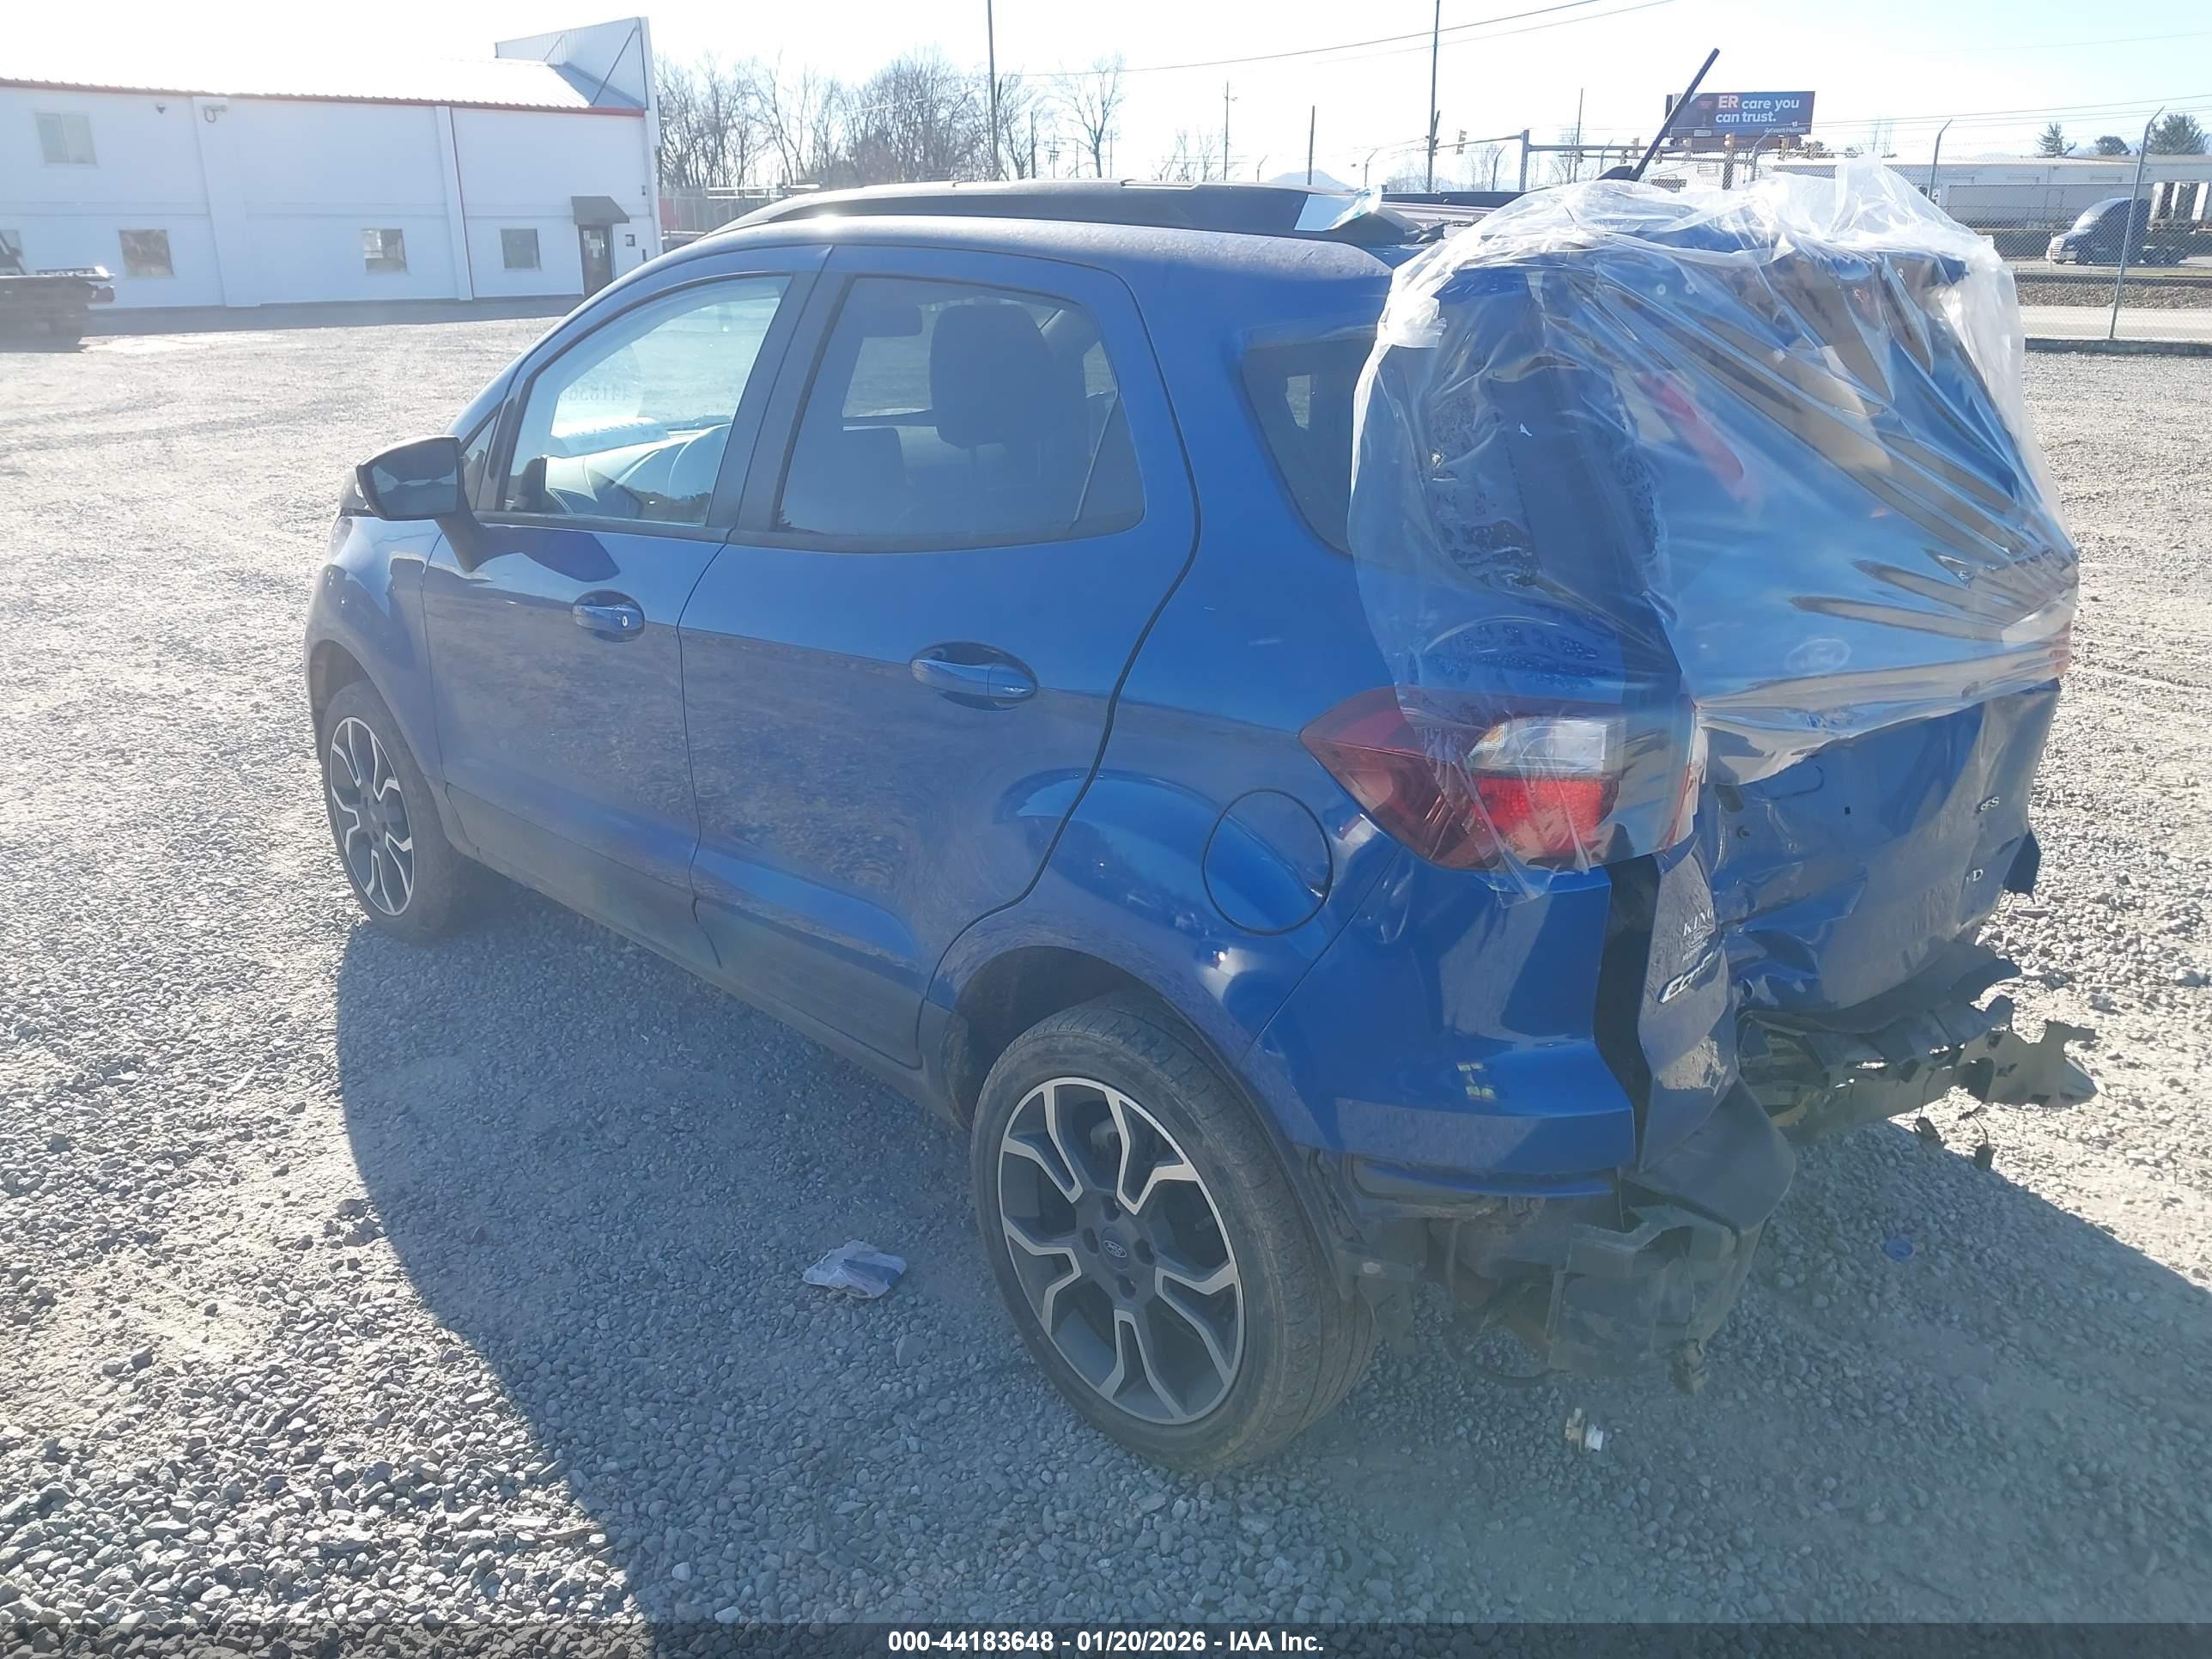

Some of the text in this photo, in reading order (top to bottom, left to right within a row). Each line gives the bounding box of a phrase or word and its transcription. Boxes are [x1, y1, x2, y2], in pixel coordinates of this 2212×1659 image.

[1718, 95, 1800, 112] ER care you
[1716, 112, 1777, 123] can trust.
